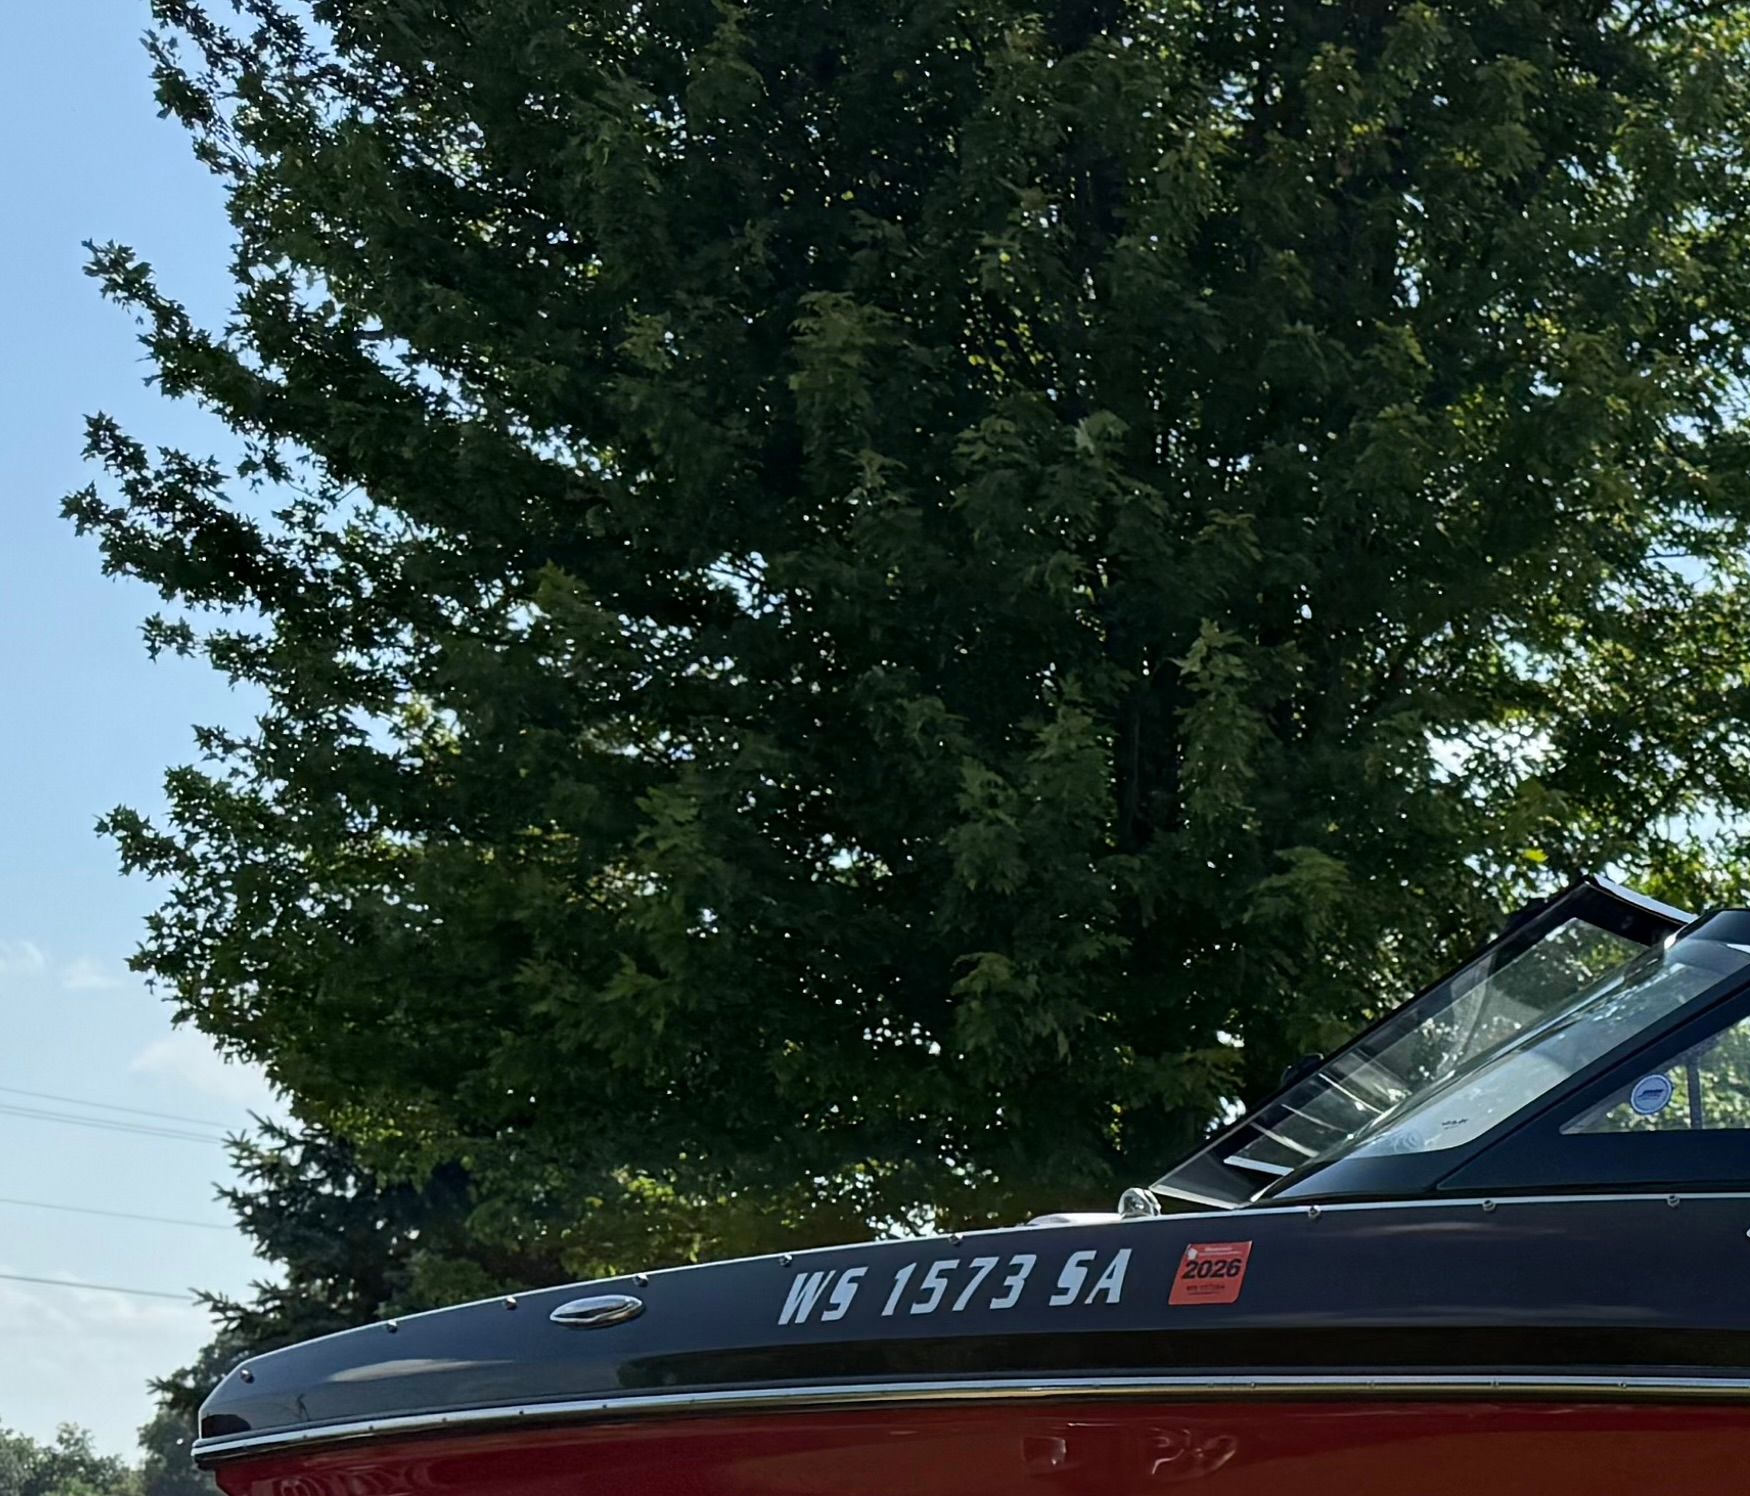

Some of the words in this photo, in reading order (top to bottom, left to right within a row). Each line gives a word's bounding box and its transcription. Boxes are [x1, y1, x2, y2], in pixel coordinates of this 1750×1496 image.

[777, 1266, 869, 1326] WS
[881, 1253, 1038, 1318] 1573
[1048, 1247, 1133, 1308] SA
[1181, 1258, 1242, 1280] 2026
